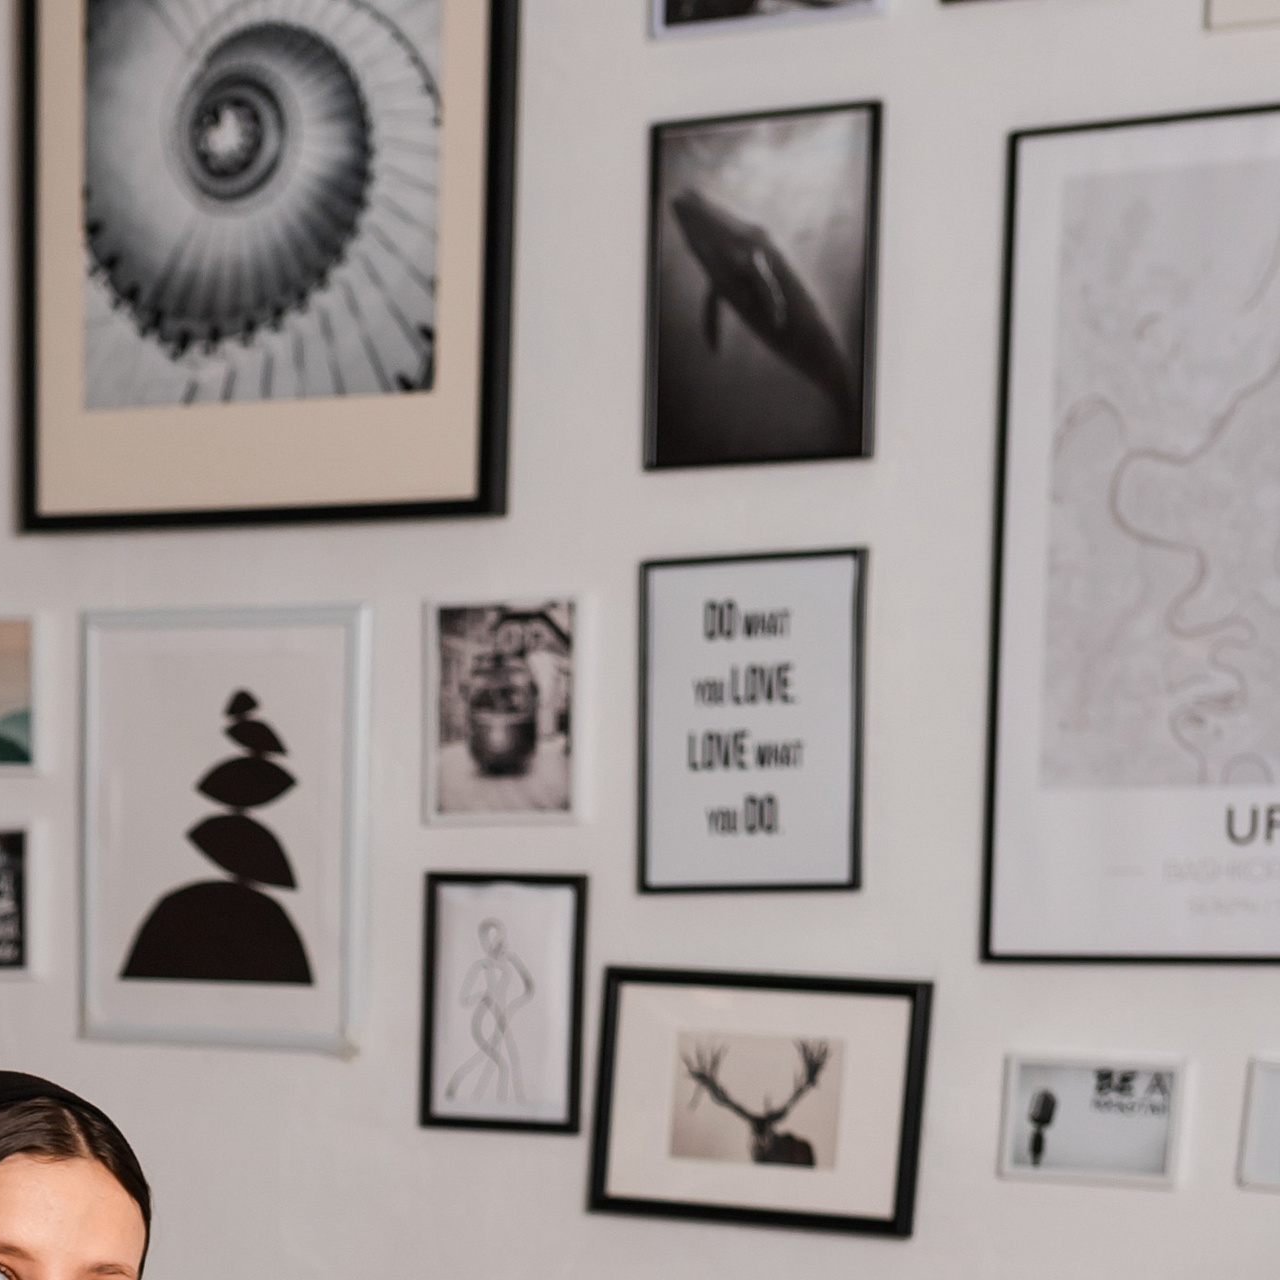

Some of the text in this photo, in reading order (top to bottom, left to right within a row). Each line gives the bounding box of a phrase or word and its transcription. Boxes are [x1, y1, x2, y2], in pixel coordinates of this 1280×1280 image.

[704, 600, 790, 640] DO WHAT
[694, 663, 793, 704] YOU LOVE
[688, 730, 804, 771] LOVE WHAT
[707, 795, 778, 834] YOU DO
